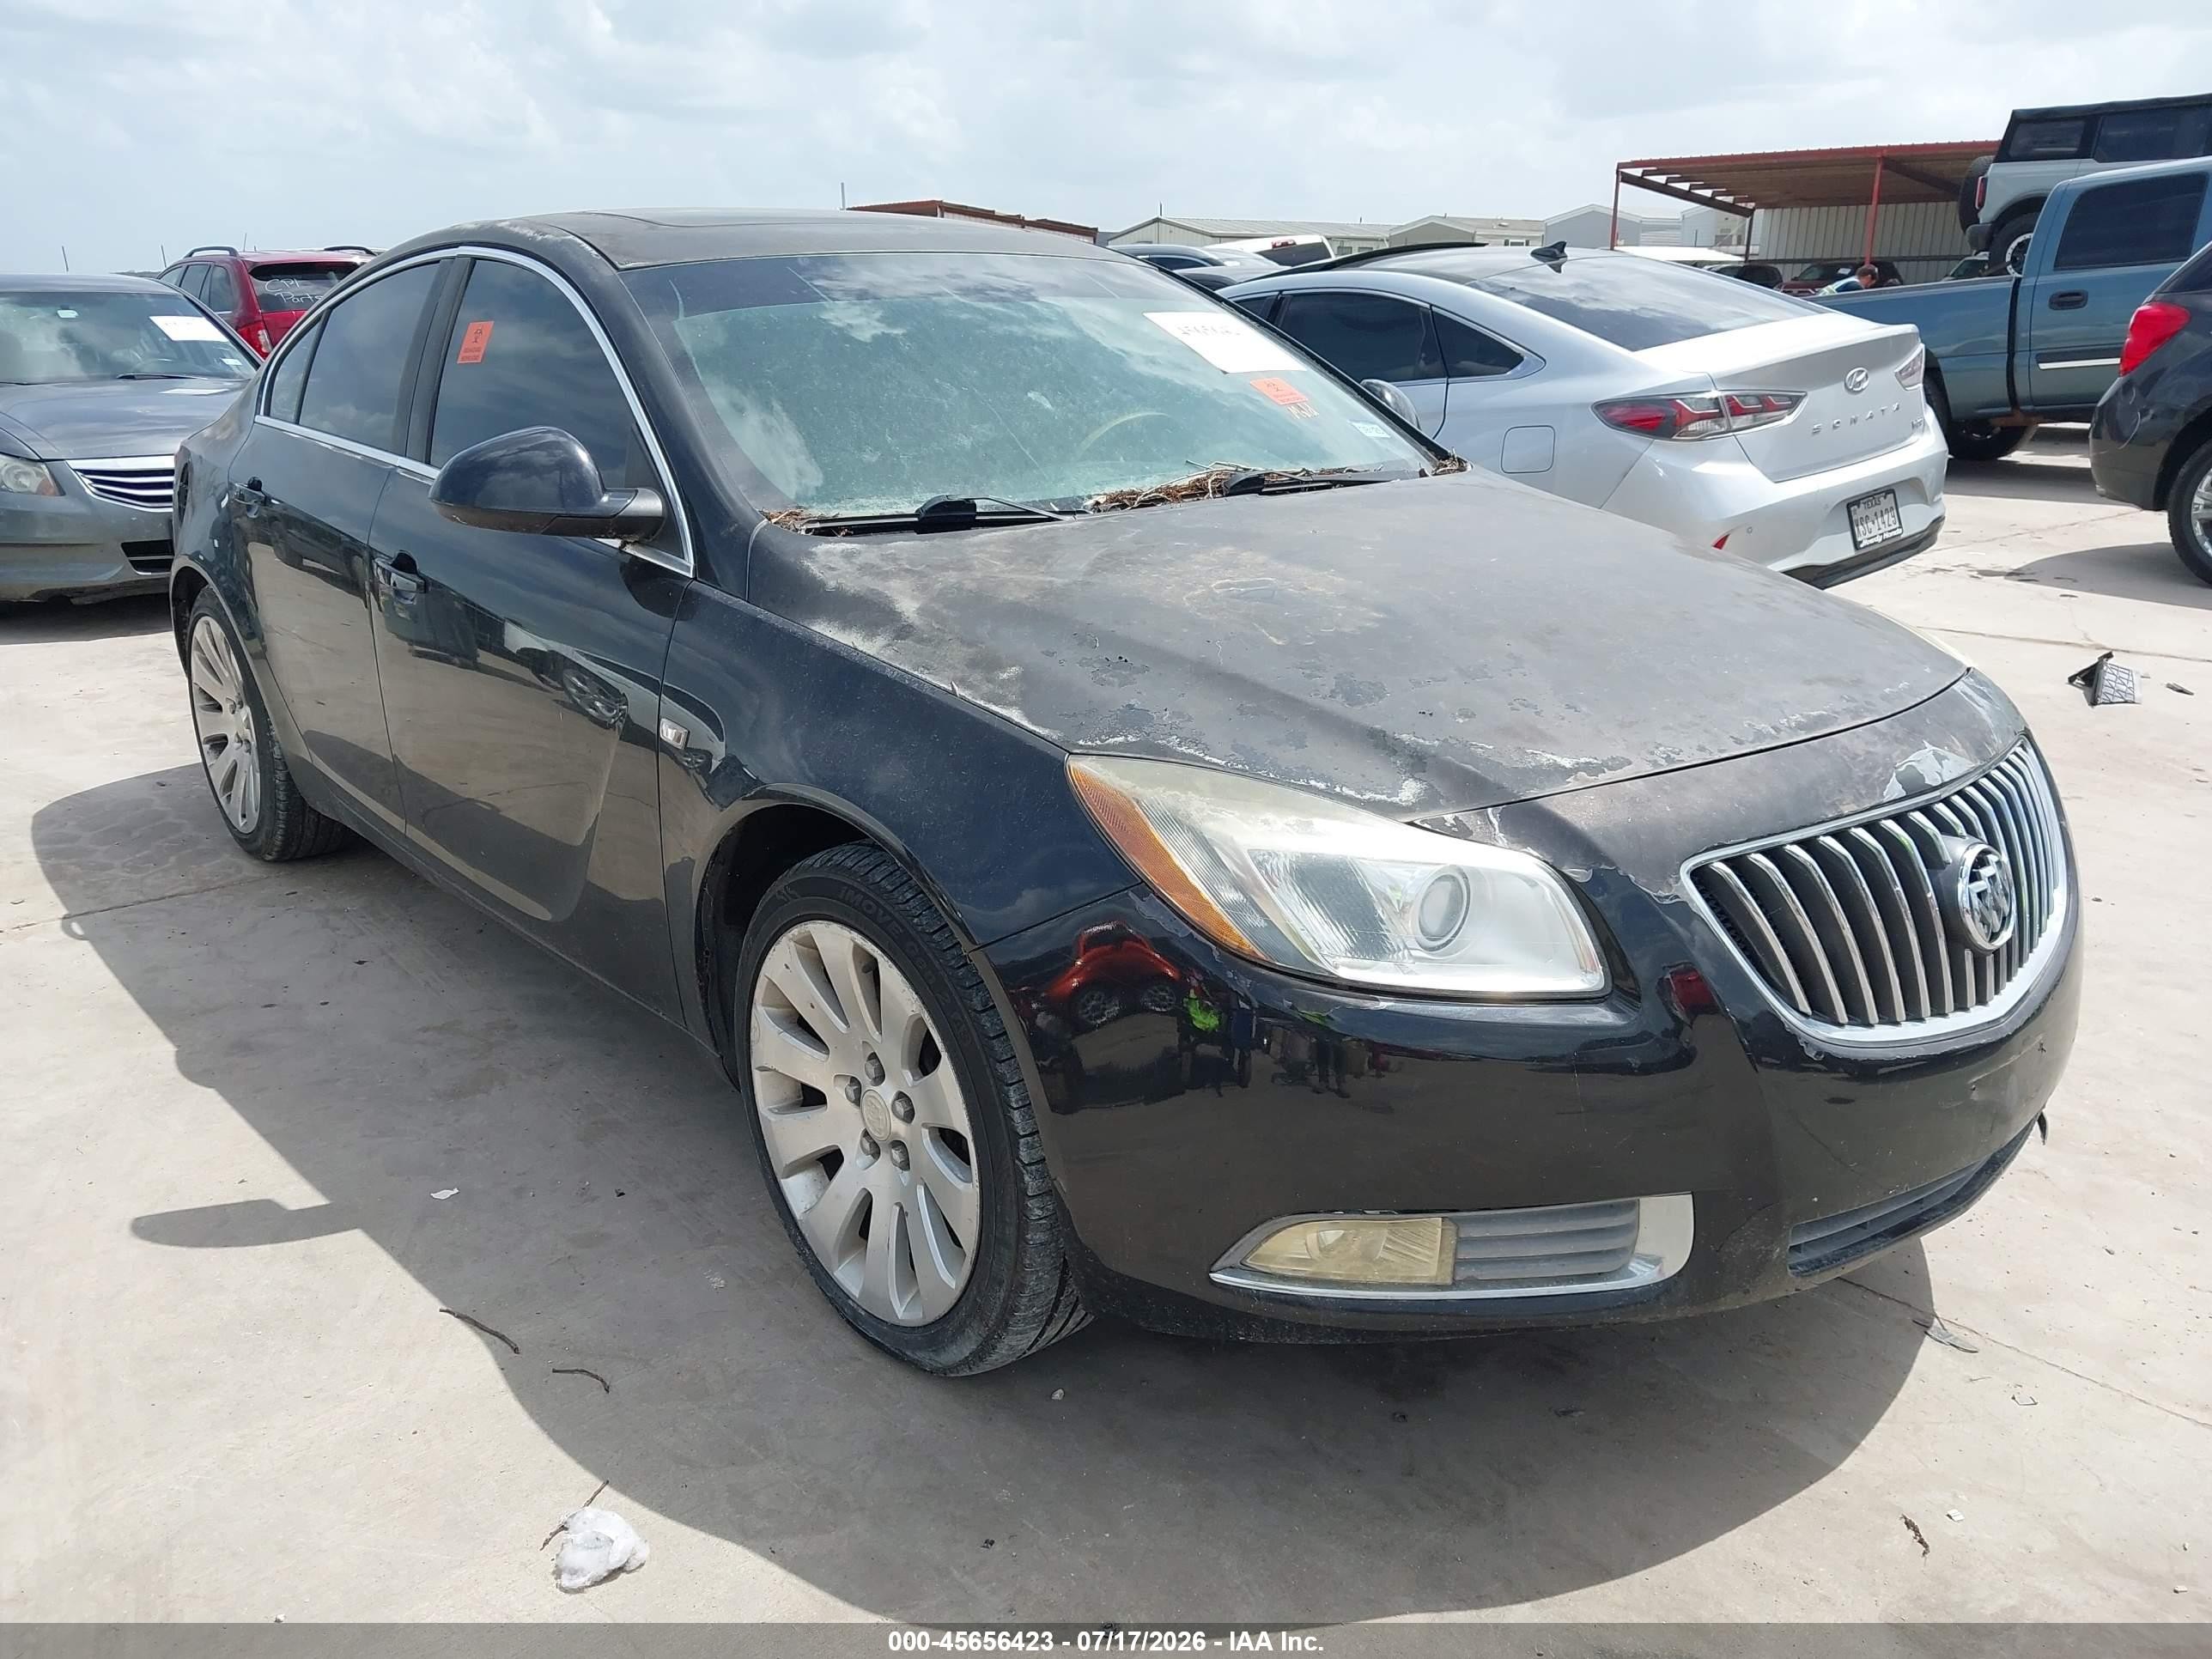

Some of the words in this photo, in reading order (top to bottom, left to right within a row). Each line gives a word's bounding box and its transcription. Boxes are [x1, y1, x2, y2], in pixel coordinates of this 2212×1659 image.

[275, 291, 324, 303] Parts
[1811, 402, 1900, 435] SONATA
[1862, 498, 1881, 509] TEXAS
